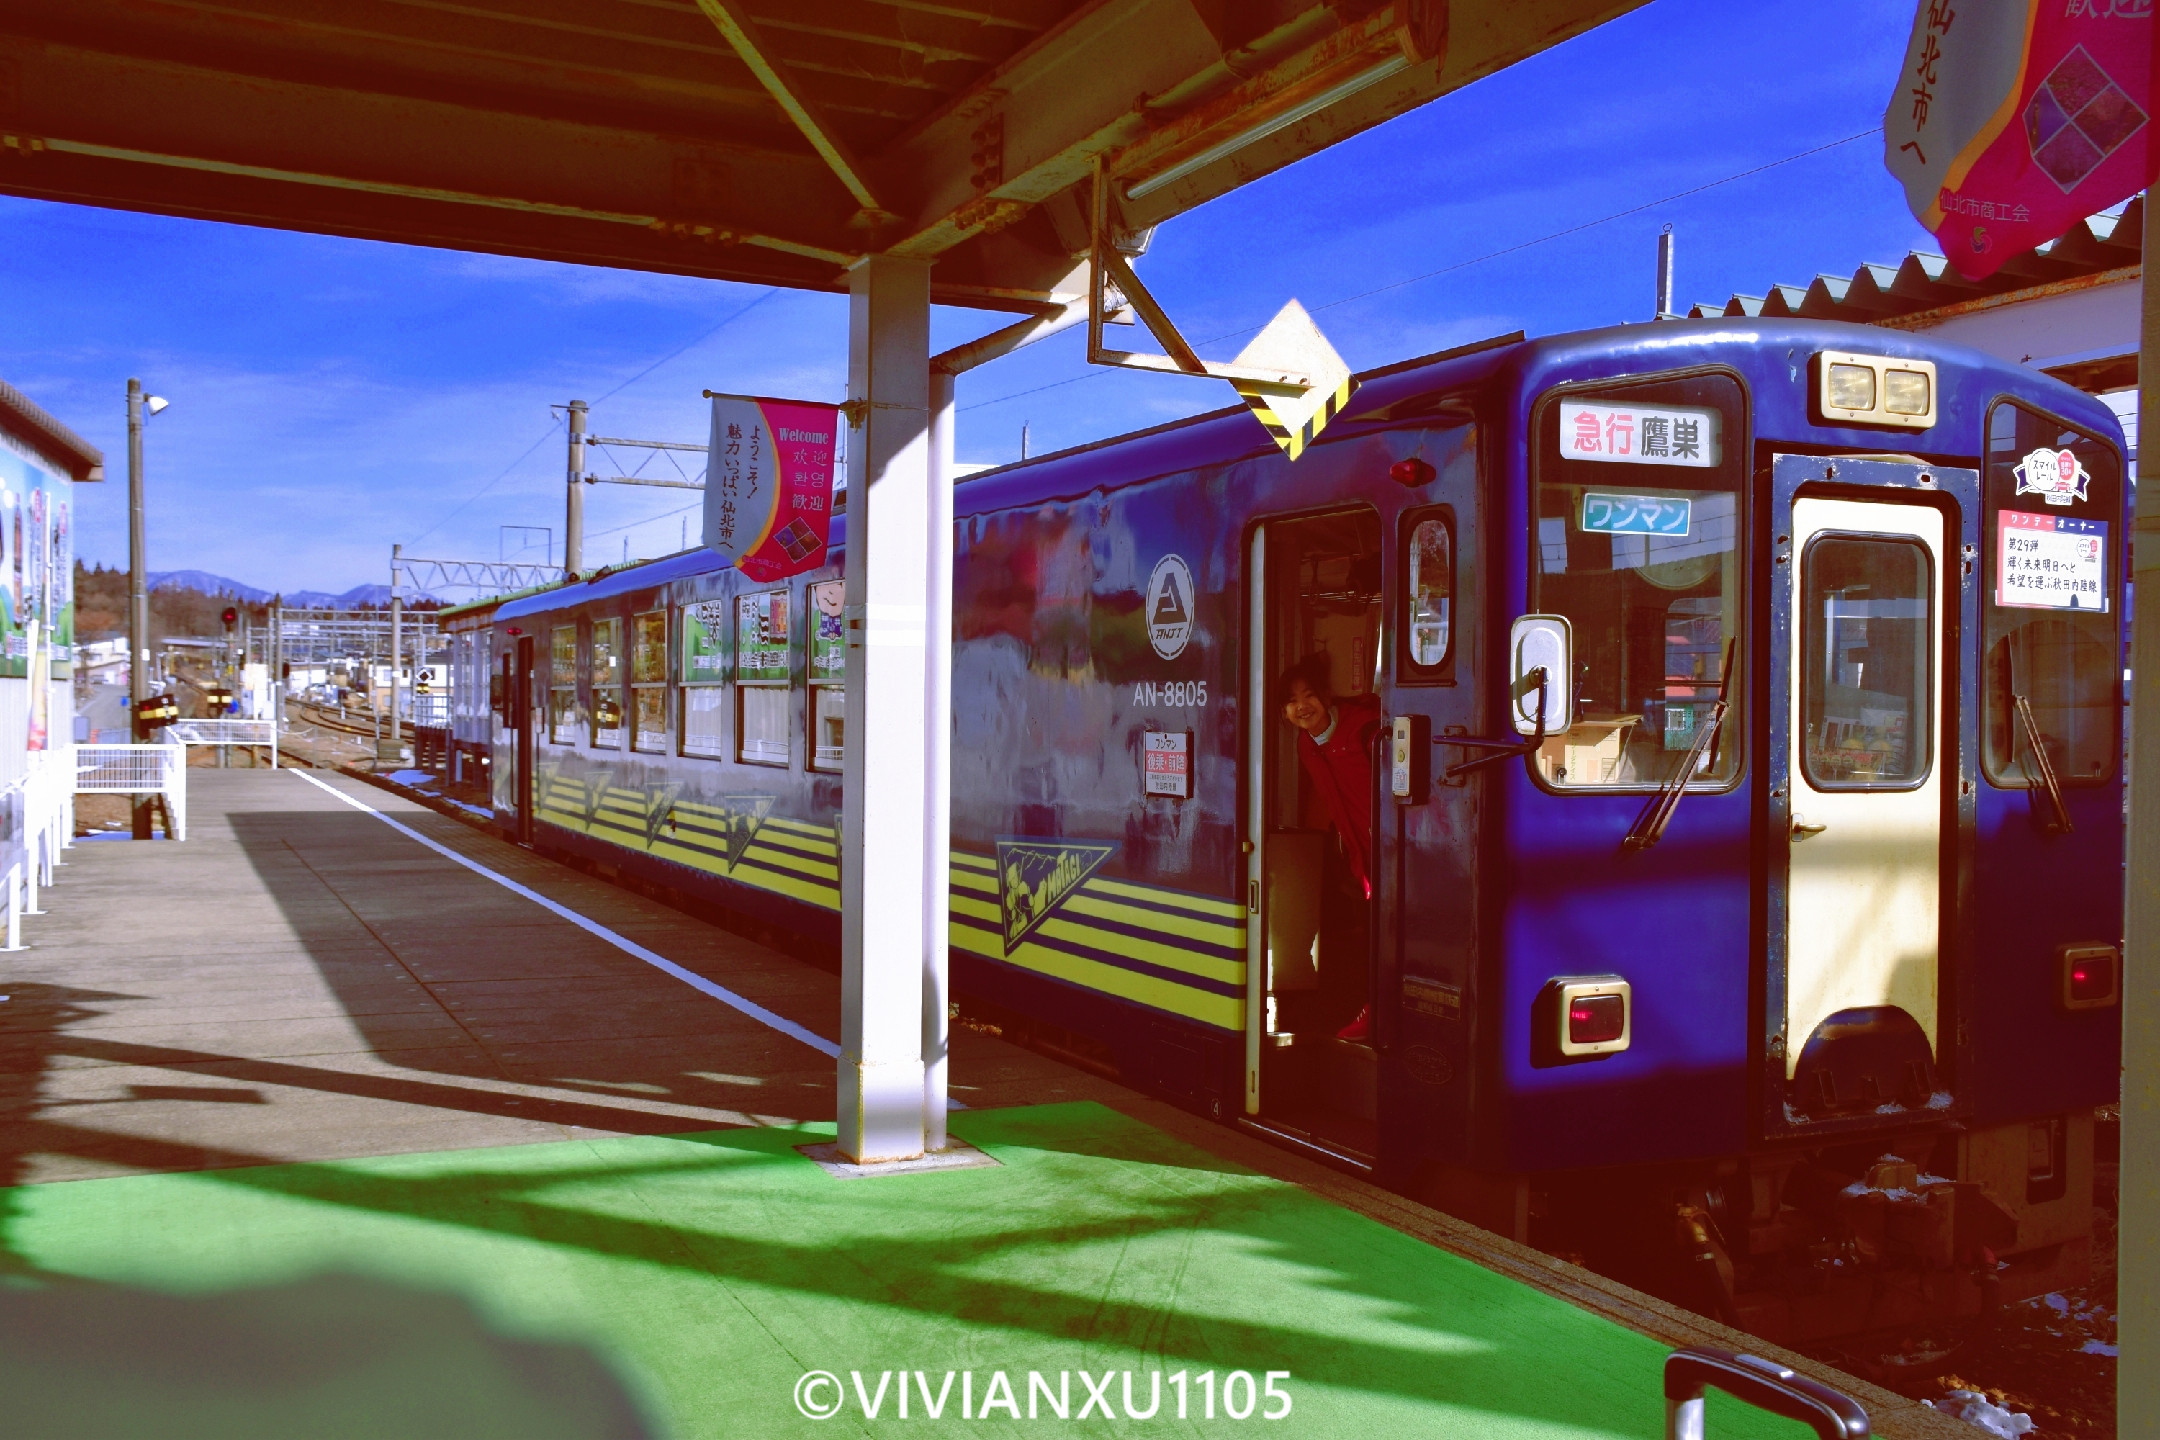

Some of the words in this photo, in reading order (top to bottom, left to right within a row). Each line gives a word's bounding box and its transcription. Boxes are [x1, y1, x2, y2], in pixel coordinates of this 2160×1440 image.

[1940, 189, 2030, 223] 仙北市商工会
[779, 427, 829, 445] Welcome
[1574, 410, 1635, 455] 急行
[1640, 415, 1700, 460] 鷹巣
[793, 448, 827, 467] 欢迎
[2033, 460, 2057, 471] スマイル
[794, 472, 825, 488] 환영
[2036, 471, 2053, 481] レール
[718, 423, 742, 549] 魅力いっぱい仙北市へ
[1588, 500, 1686, 531] ワンマン
[2008, 537, 2039, 552] 第29弾
[2007, 556, 2076, 573] 輝く未来明日へと
[1133, 681, 1208, 708] AN-8805
